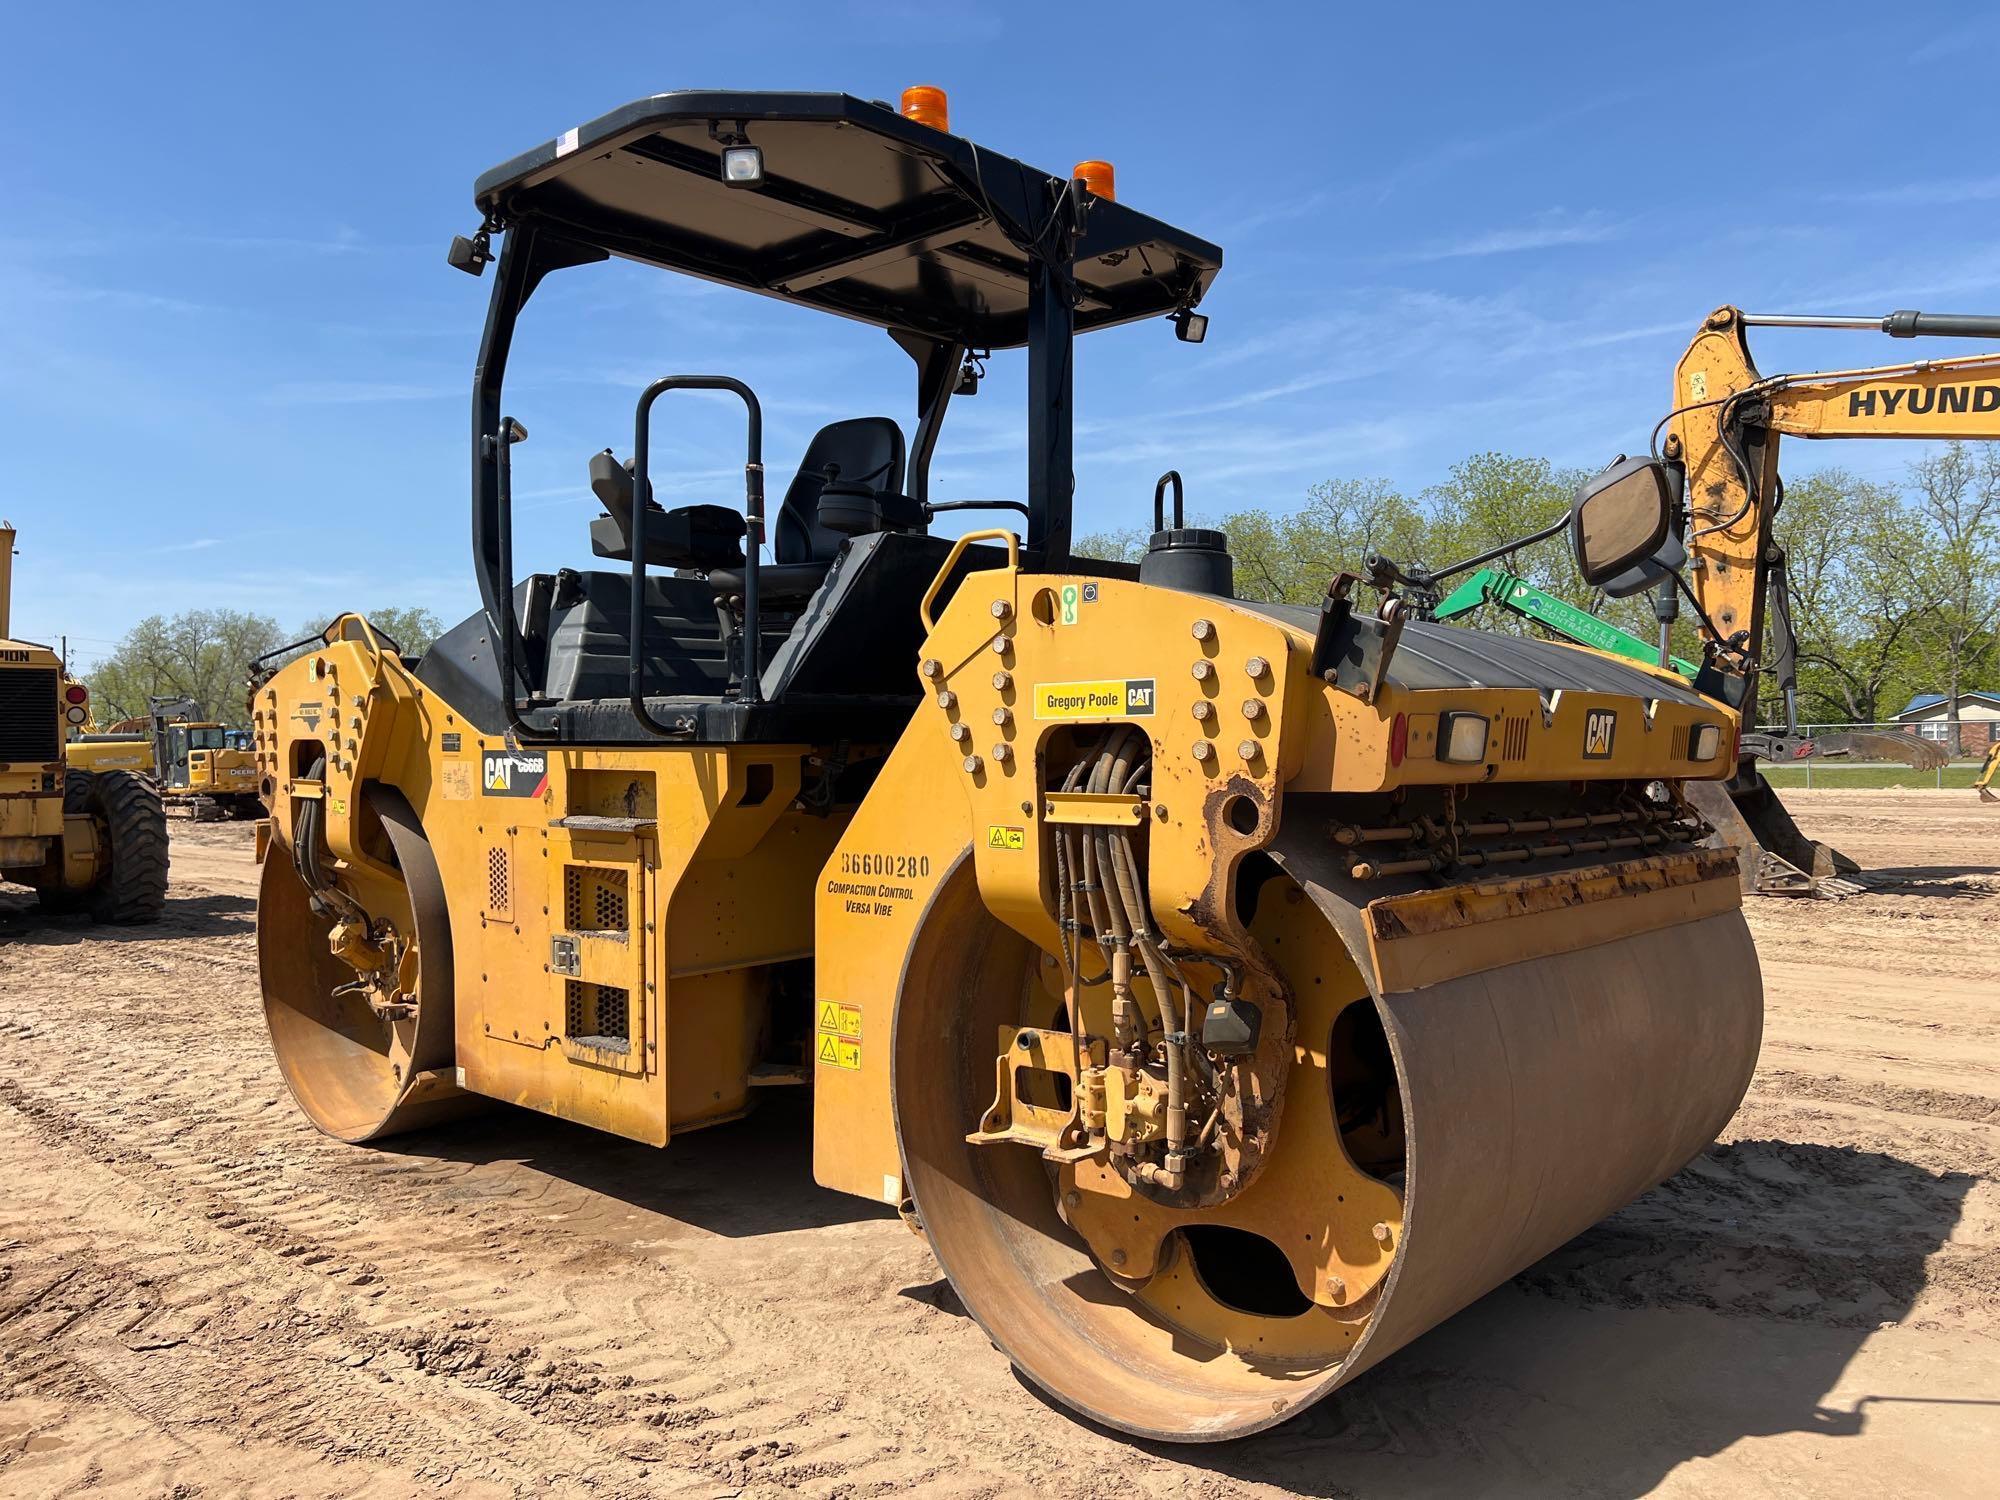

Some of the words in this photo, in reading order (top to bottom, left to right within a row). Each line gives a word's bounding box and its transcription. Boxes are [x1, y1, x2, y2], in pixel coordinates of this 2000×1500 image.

[1849, 386, 2000, 417] HYUND
[1541, 608, 1614, 649] CONTRACTING
[1544, 603, 1617, 642] MIDSTATES
[1047, 695, 1086, 710] Gregory
[1089, 693, 1118, 706] Poole
[1127, 688, 1152, 707] CAT
[1586, 714, 1614, 754] CAT
[484, 757, 513, 790] CAT
[841, 853, 930, 879] 36600280
[827, 880, 877, 897] COMPACTION
[878, 884, 914, 900] CONTROL
[845, 900, 871, 914] VERSA
[873, 902, 893, 916] VIBE
